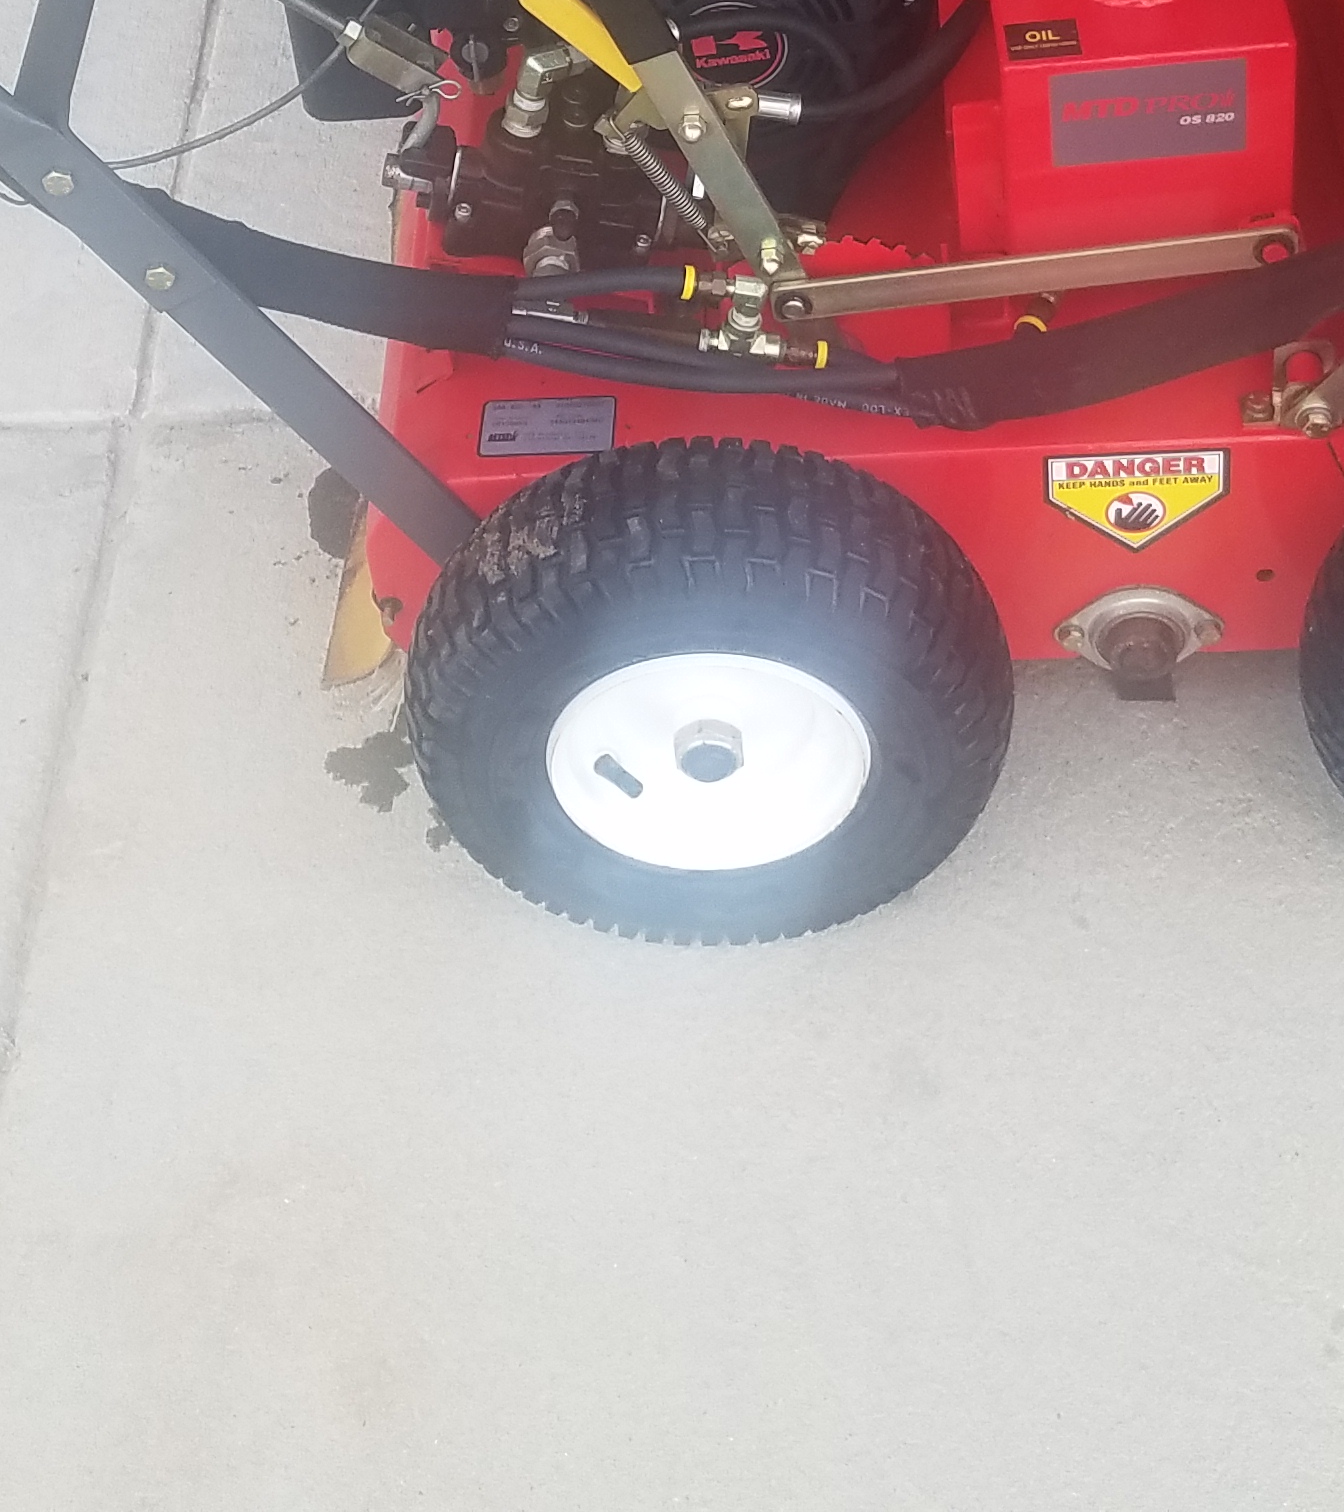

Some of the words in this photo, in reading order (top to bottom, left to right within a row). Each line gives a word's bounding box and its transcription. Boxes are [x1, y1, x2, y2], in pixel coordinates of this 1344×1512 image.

[1025, 30, 1060, 42] OIL
[696, 48, 771, 68] Kawasaki
[1061, 96, 1139, 122] MTD
[1144, 92, 1219, 114] PRO
[1179, 115, 1201, 126] OS
[1206, 112, 1235, 123] 820
[504, 338, 542, 354] U.S.A.
[1066, 456, 1205, 479] DANGER
[1058, 481, 1085, 490] KEEP
[1089, 480, 1125, 488] HANDS
[1129, 478, 1149, 487] and
[1152, 476, 1178, 486] FEET
[1182, 475, 1213, 484] AWAY
